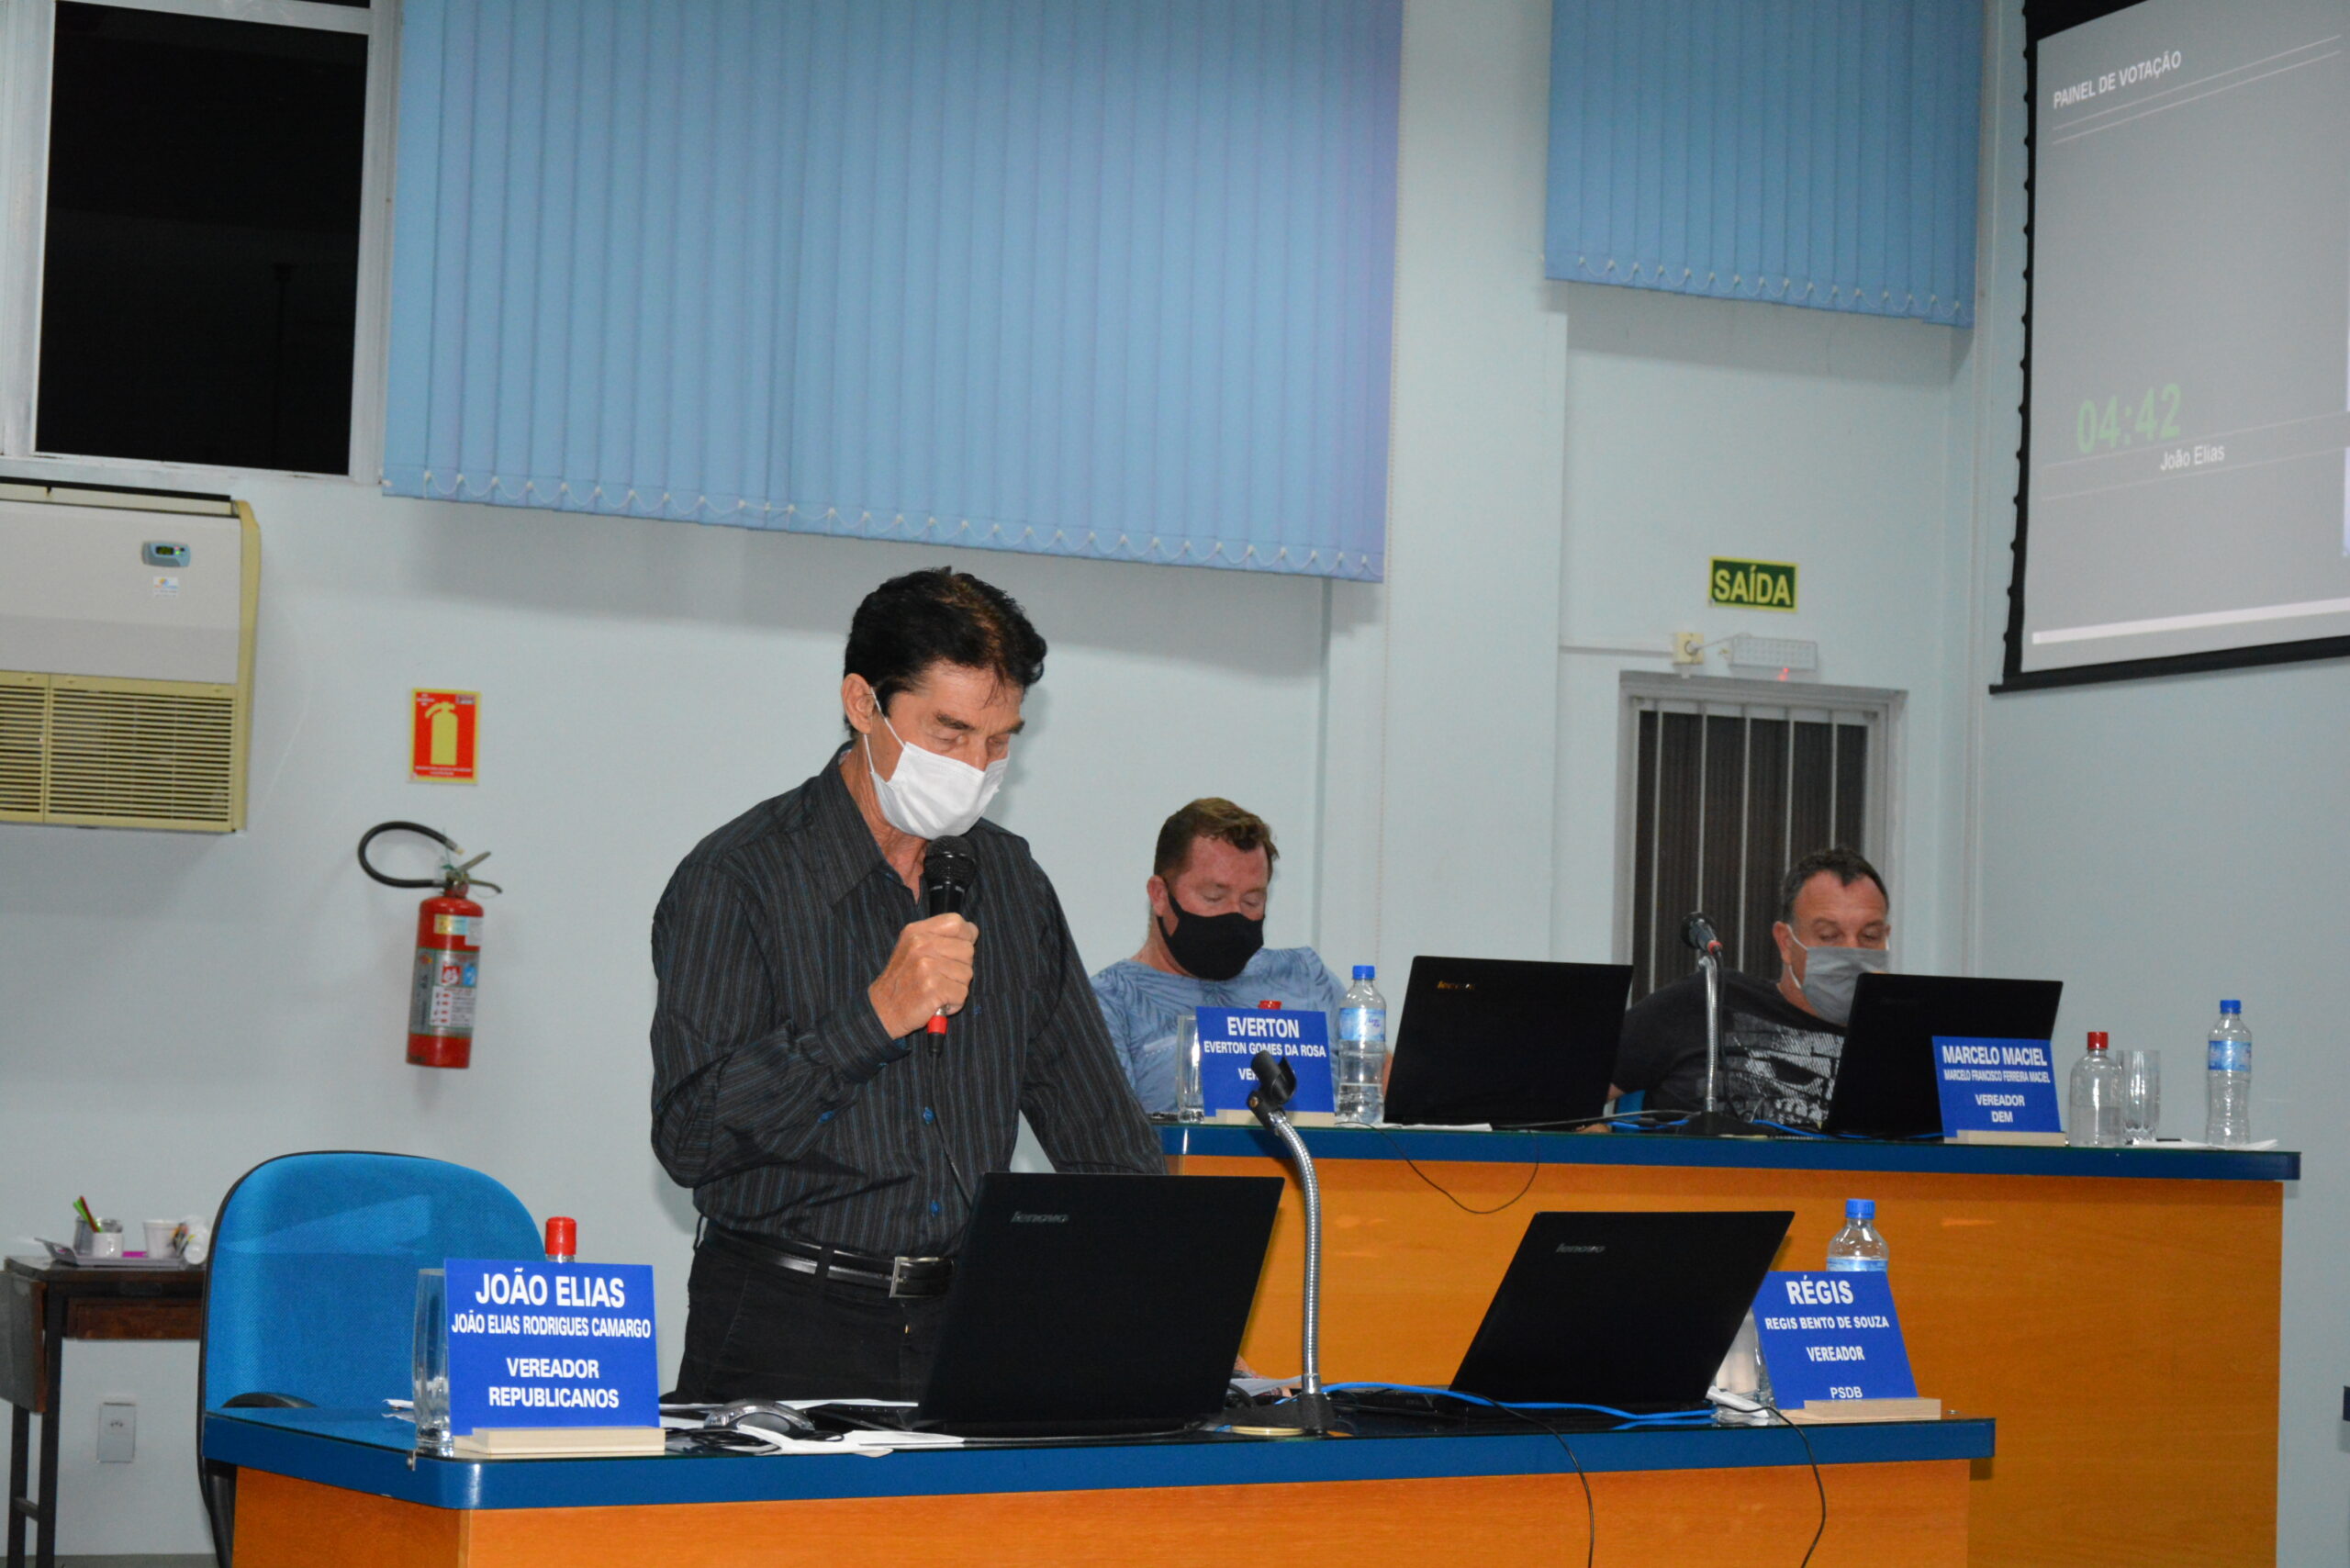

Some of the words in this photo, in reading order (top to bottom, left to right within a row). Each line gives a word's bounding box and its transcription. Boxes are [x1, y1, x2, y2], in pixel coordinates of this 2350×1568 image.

[2053, 80, 2096, 110] PAINEL
[2098, 73, 2116, 95] DE
[2119, 50, 2182, 86] VOTAÇÃO
[2076, 382, 2182, 454] 04:42
[2160, 448, 2190, 471] João
[2194, 443, 2225, 465] Elias
[1714, 565, 1792, 606] SAÍDA
[1226, 1016, 1300, 1039] EVERTON
[1203, 1040, 1248, 1055] EVERTON
[1248, 1042, 1283, 1057] GOMES
[1284, 1044, 1299, 1057] DA
[1300, 1045, 1327, 1058] ROSA
[1942, 1045, 2001, 1066] MARCELO
[2002, 1047, 2048, 1067] MACIEL
[1942, 1069, 1972, 1081] MARCELO
[1975, 1093, 2026, 1107] VEREADOR
[1990, 1110, 2014, 1124] DEM
[475, 1267, 548, 1306] JOÃO
[555, 1275, 626, 1308] ELIAS
[1785, 1274, 1854, 1305] RÉGIS
[451, 1309, 485, 1334] JOÃO
[487, 1315, 520, 1335] ELIAS
[522, 1316, 589, 1337] RODRIGUES
[591, 1317, 652, 1338] CAMARGO
[1764, 1316, 1798, 1330] REGIS
[1799, 1316, 1836, 1329] BENTO
[1837, 1316, 1852, 1329] DE
[1853, 1315, 1890, 1328] SOUZA
[1806, 1345, 1865, 1362] VEREADOR
[506, 1357, 599, 1379] VEREADOR
[488, 1386, 620, 1408] REPUBLICANOS
[1830, 1385, 1863, 1400] PSDB
